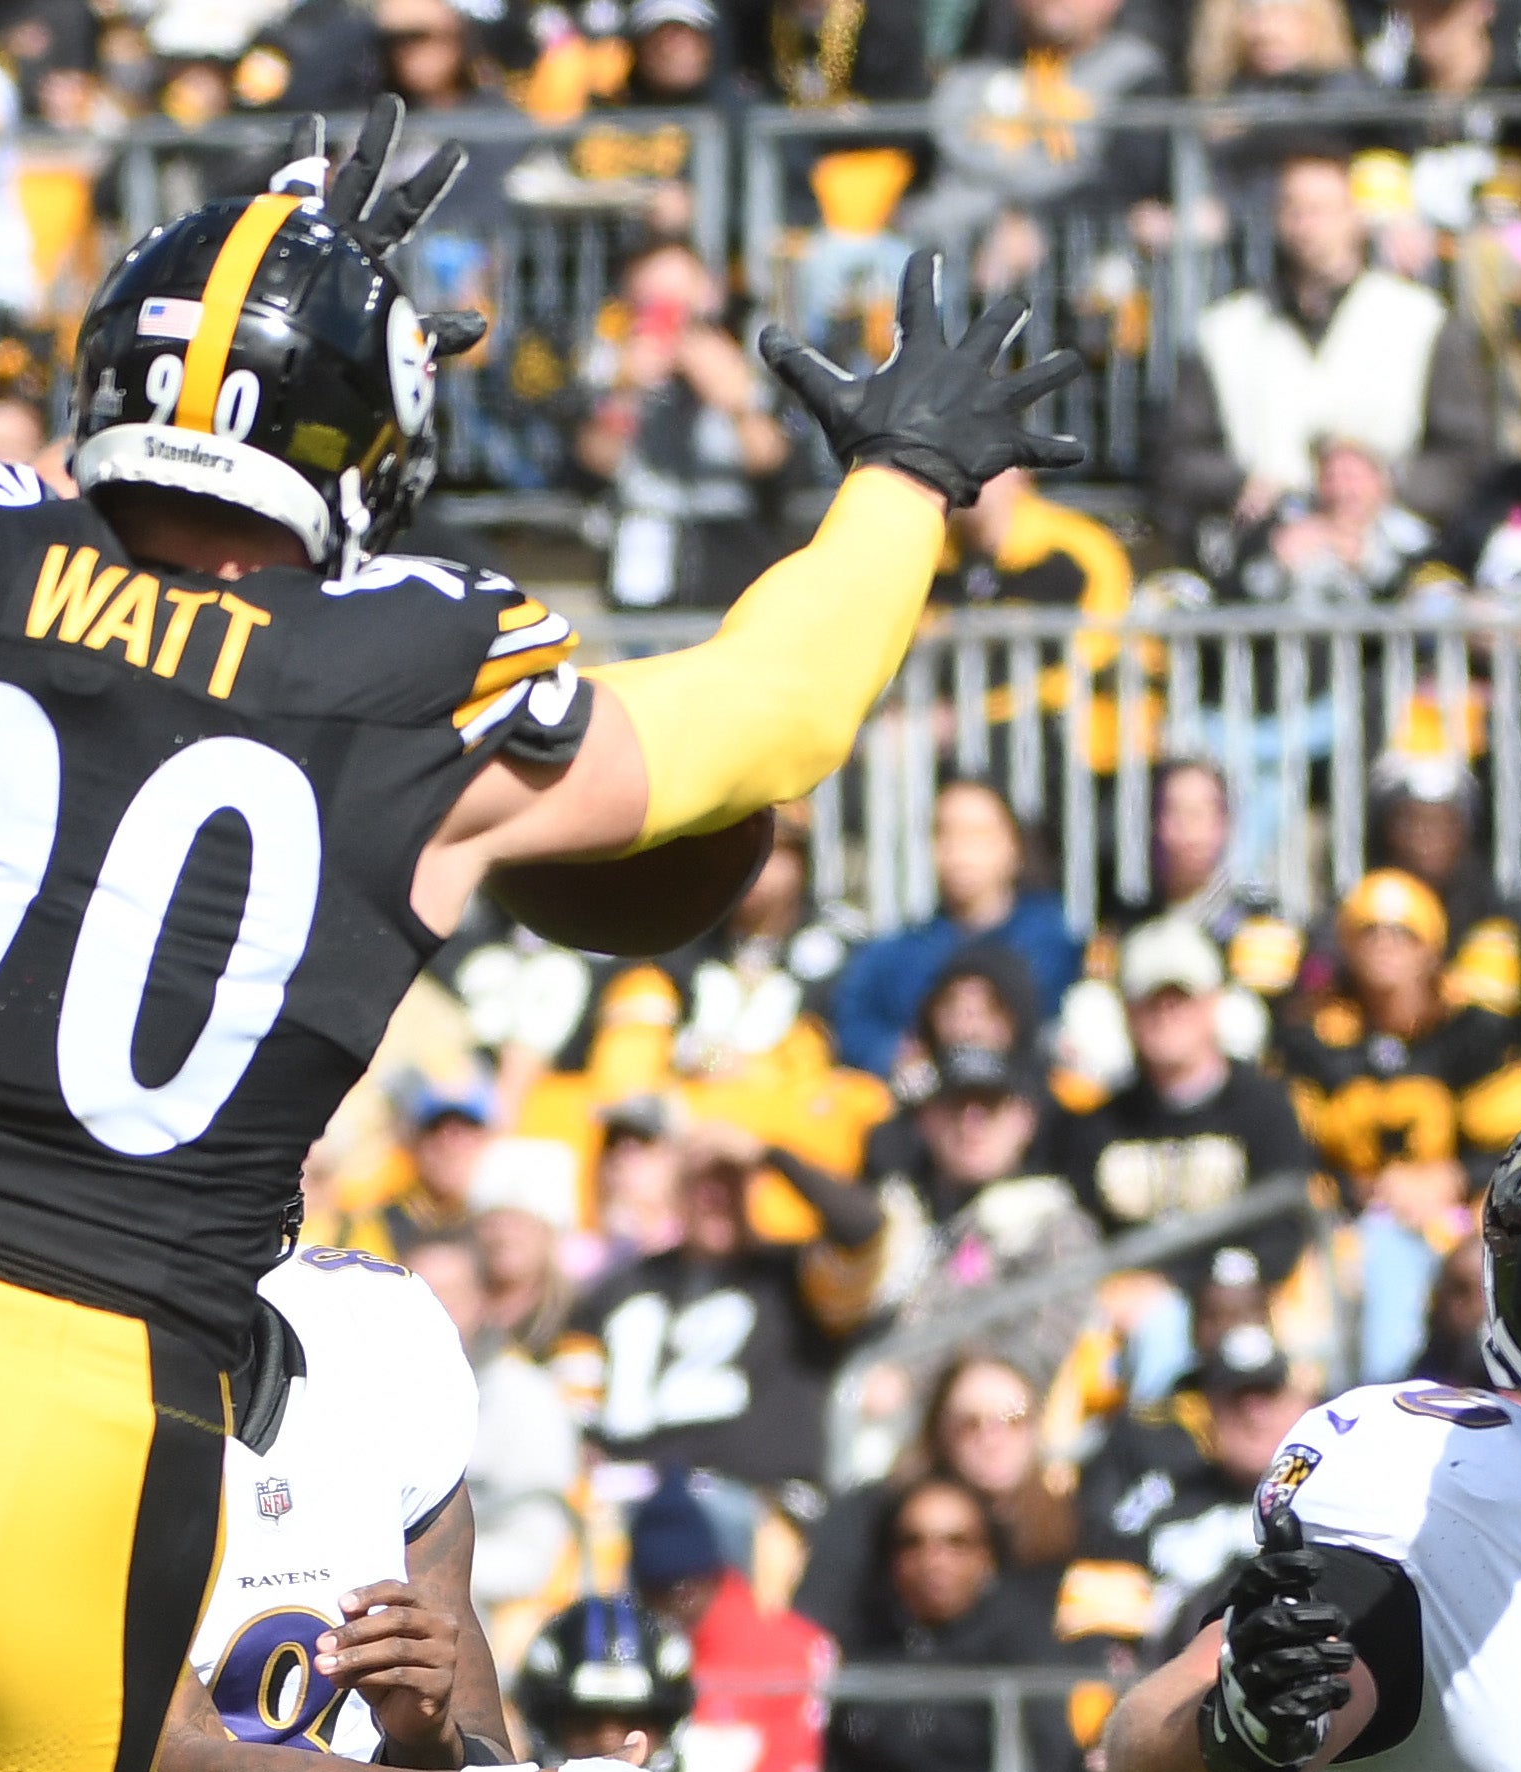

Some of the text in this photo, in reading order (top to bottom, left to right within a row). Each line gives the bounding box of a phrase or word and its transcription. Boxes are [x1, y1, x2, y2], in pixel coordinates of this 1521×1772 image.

[146, 354, 260, 443] 90
[24, 543, 273, 701] WATT
[602, 1288, 758, 1438] 12
[261, 1491, 292, 1515] NFL
[238, 1568, 332, 1590] RAVENS
